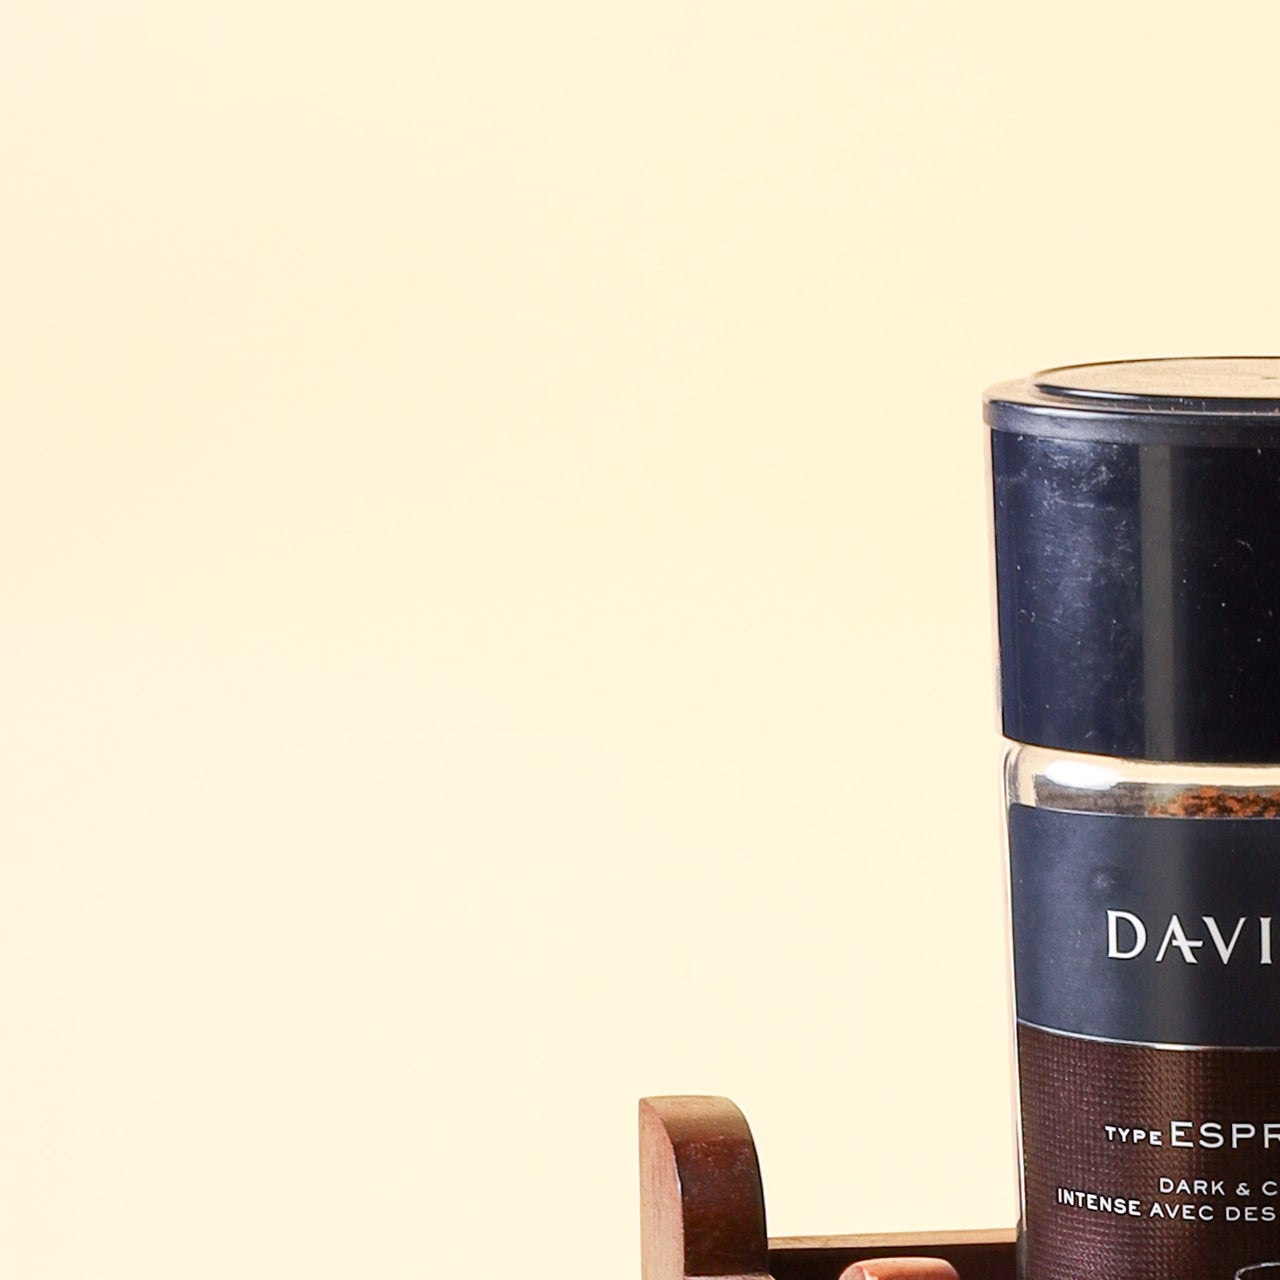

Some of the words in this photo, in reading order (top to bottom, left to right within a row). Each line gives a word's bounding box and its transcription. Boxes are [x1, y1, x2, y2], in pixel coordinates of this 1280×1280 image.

[1105, 1126, 1163, 1146] TYPE
[1159, 1177, 1225, 1196] DARK
[1235, 1182, 1250, 1196] &
[1057, 1188, 1142, 1217] INTENSE
[1149, 1203, 1214, 1221] AVEC
[1225, 1206, 1276, 1222] DES
